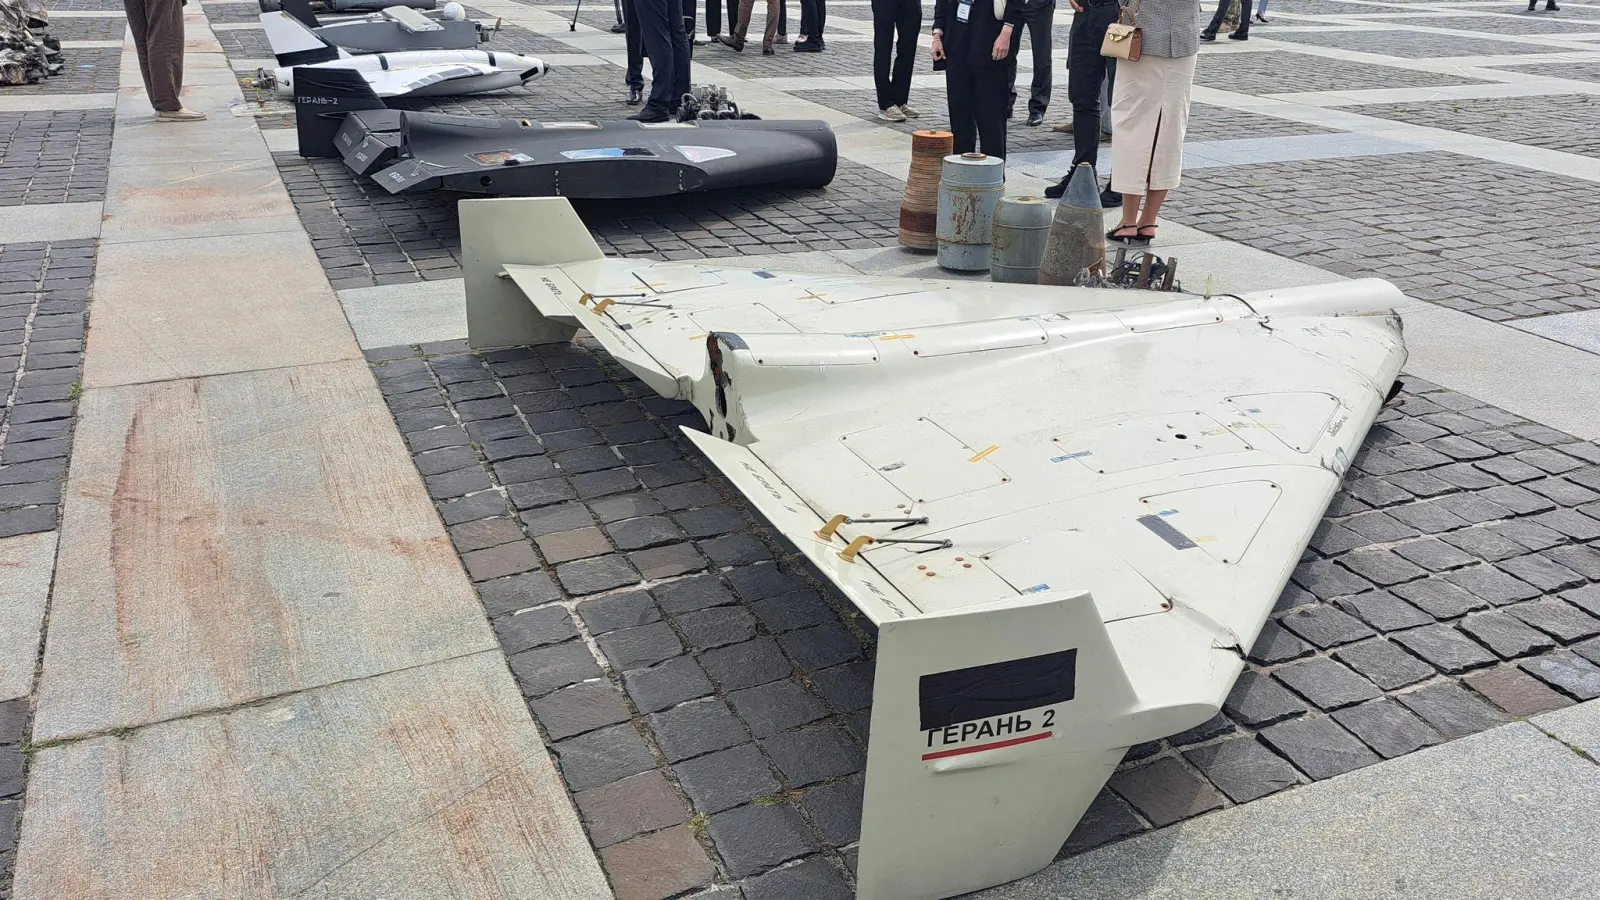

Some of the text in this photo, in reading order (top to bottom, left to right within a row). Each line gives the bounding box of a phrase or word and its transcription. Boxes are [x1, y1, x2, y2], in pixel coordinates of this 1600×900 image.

[297, 96, 338, 105] ГЕРАНЬ-2
[860, 579, 885, 597] НЕ
[927, 708, 1056, 748] ГЕРАНЬ 2
